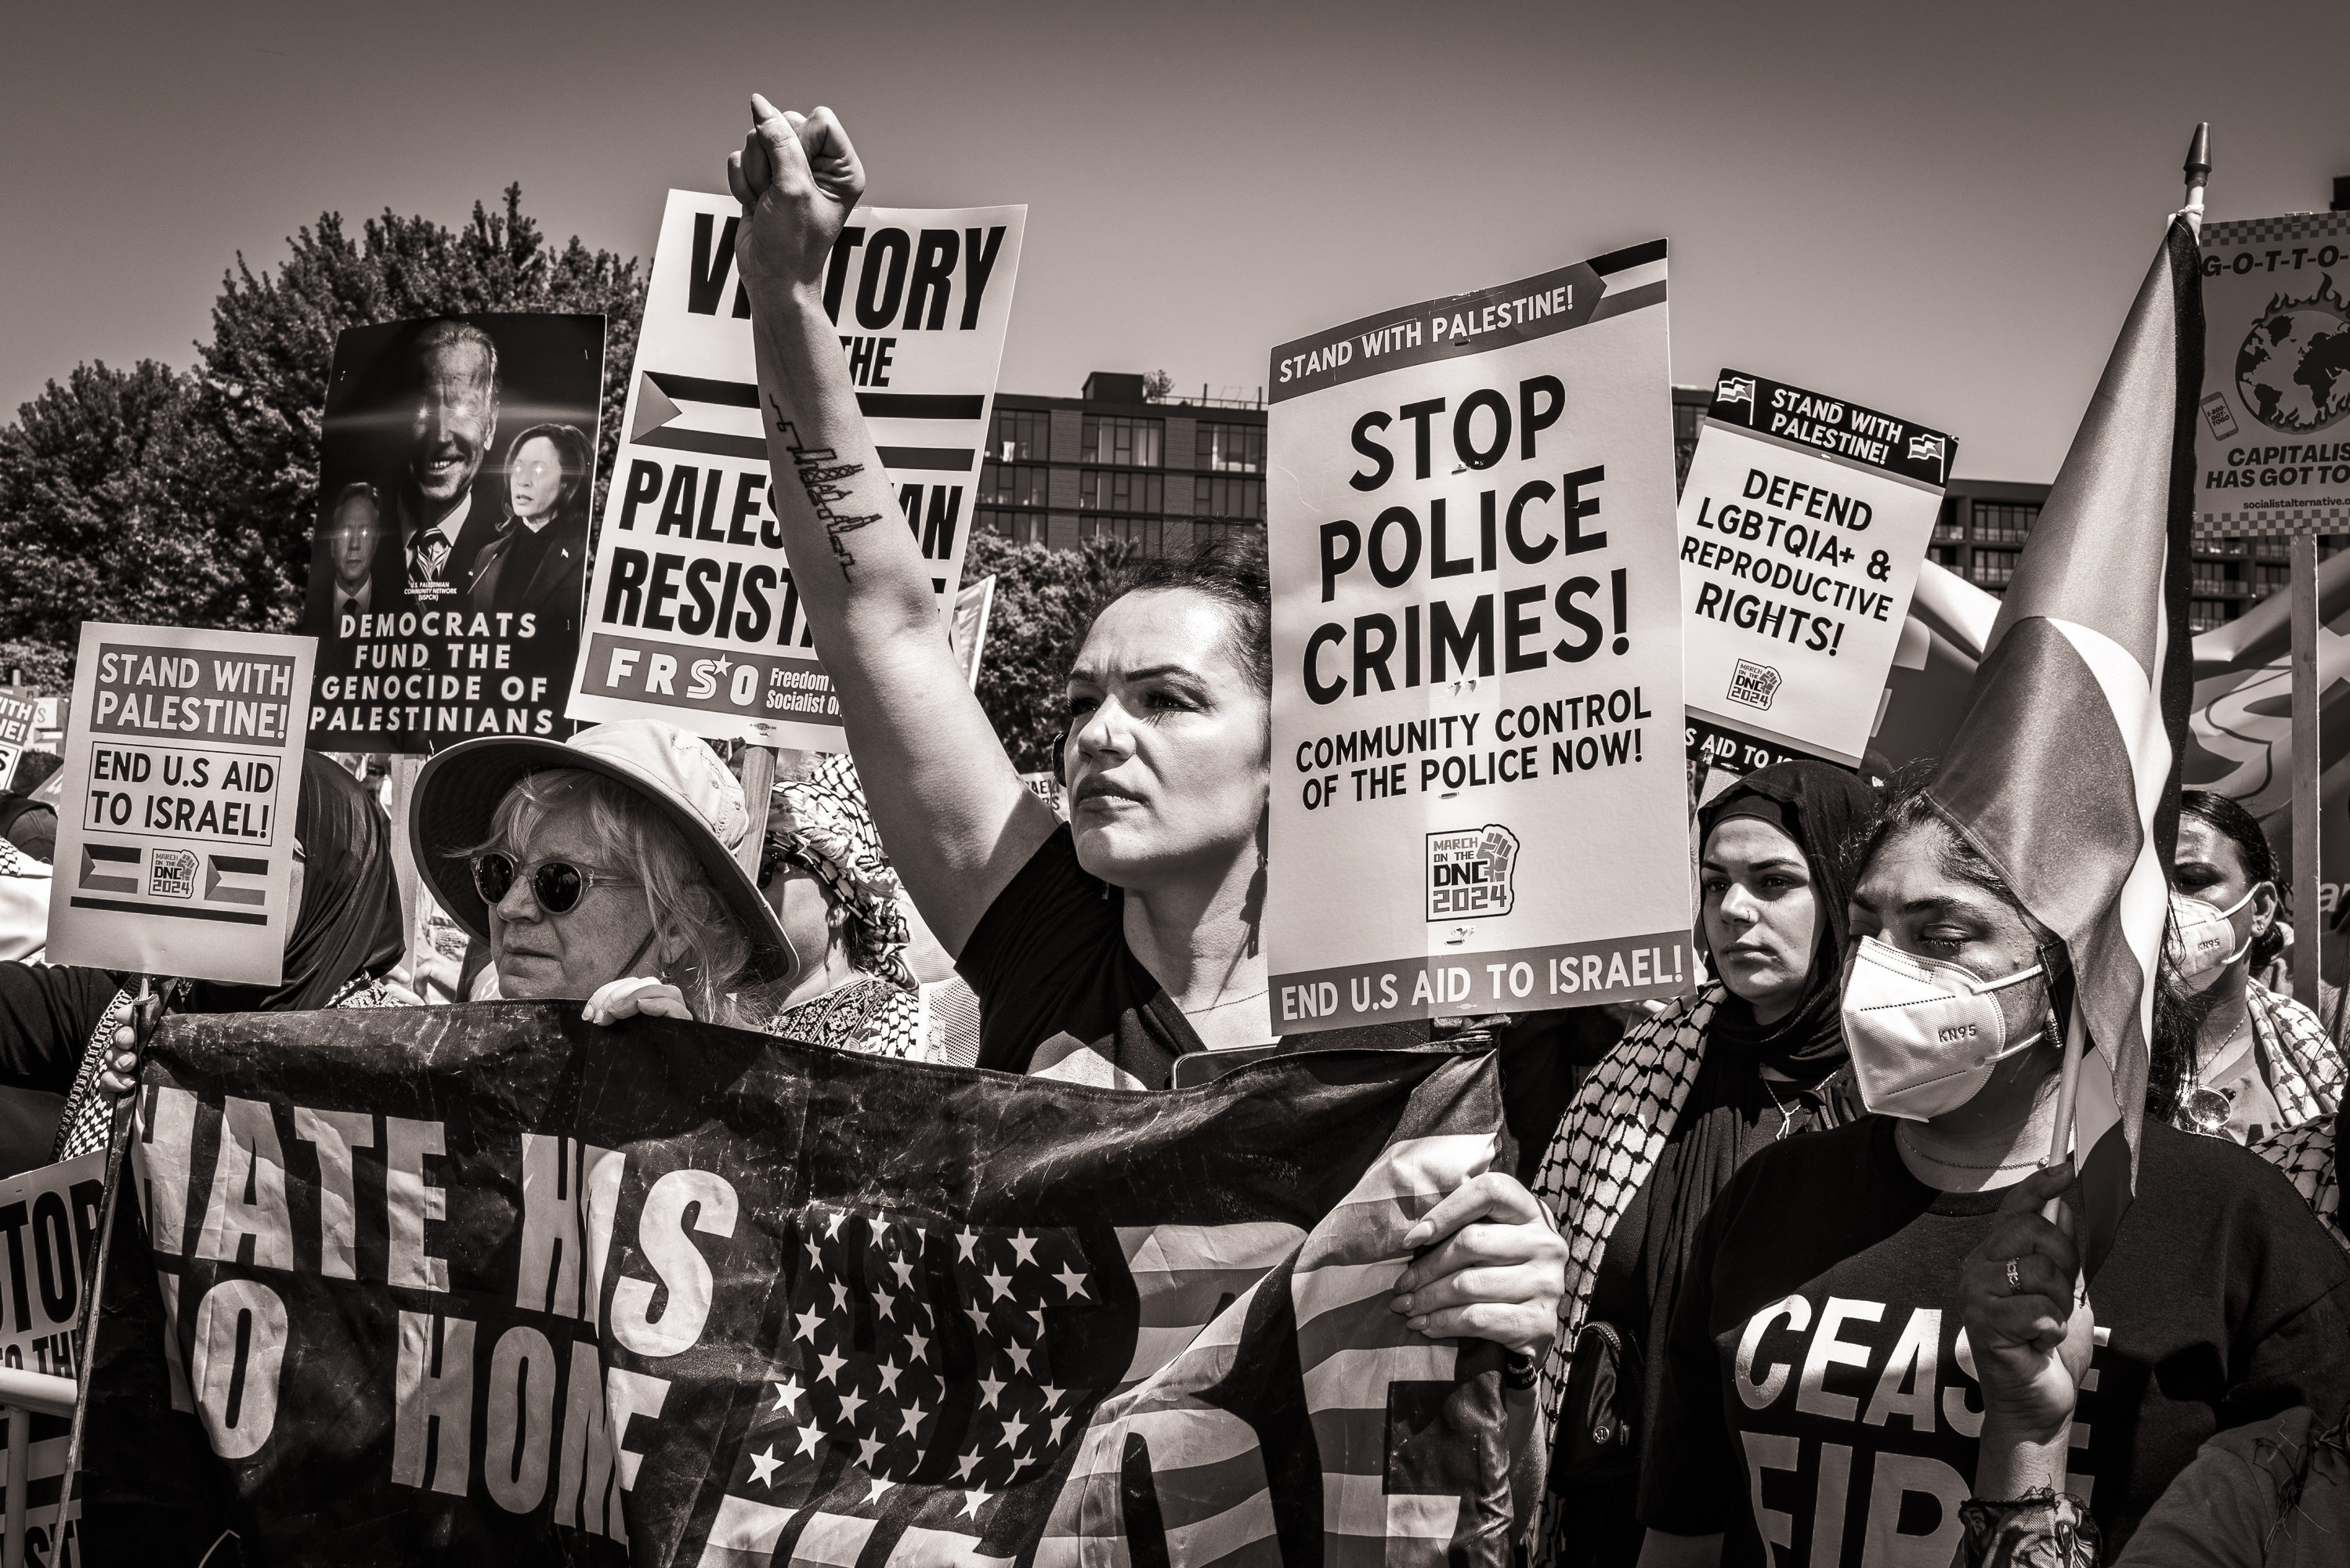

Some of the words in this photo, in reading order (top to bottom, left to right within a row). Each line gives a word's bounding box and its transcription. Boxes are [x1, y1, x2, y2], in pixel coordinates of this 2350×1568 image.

[688, 212, 1007, 331] VTORY
[1279, 341, 1353, 383] STAND
[1361, 321, 1422, 359] WITH
[1432, 284, 1573, 343] PALESTINE!
[1348, 374, 1565, 492] STOP
[1771, 388, 1843, 425] STAND
[1852, 410, 1903, 444] WITH
[1771, 413, 1889, 464] PALESTINE!
[2206, 469, 2255, 489] HAS
[2259, 466, 2314, 487] GOT
[2317, 464, 2350, 484] TO
[1742, 468, 1873, 532] DEFEND
[1320, 464, 1607, 603] POLICE
[1697, 497, 1855, 567] LGBTQIA+
[1866, 549, 1892, 583] &
[1680, 536, 1893, 623] REPRODUCTIVE
[340, 612, 536, 638] DEMOCRATS
[1694, 582, 1846, 656] RIGHTS!
[1303, 568, 1630, 706] CRIMES!
[355, 644, 428, 669] FUND
[447, 644, 511, 669] THE
[1740, 663, 1762, 674] MARCH
[99, 652, 200, 689] STAND
[214, 659, 291, 696] WITH
[321, 675, 481, 699] GENOCIDE
[501, 676, 548, 702] OF
[769, 667, 830, 692] Freedom
[1735, 674, 1764, 692] DNC
[766, 689, 826, 714] Socialist
[1731, 686, 1769, 706] 2024
[95, 691, 287, 739] PALESTINE!
[309, 706, 553, 735] PALESTINIANS
[1296, 713, 1480, 772] COMMUNITY
[1495, 686, 1651, 742] CONTROL
[1700, 734, 1737, 758] AID
[1744, 745, 1770, 768] TO
[94, 750, 150, 784] END
[163, 754, 210, 789] U.S
[221, 761, 274, 793] AID
[1302, 778, 1338, 811] OF
[1354, 763, 1407, 802] THE
[1421, 746, 1538, 793] POLICE
[1553, 728, 1643, 775] NOW!
[90, 790, 132, 826] TO
[145, 795, 269, 839] ISRAEL!
[1434, 837, 1477, 851] MARCH
[1434, 853, 1448, 862] ON
[1454, 851, 1474, 861] THE
[153, 880, 190, 894] 2024
[154, 866, 182, 880] DNC
[1434, 861, 1488, 887] DNC
[1433, 884, 1506, 913] 2024
[2196, 938, 2220, 952] KN95
[1281, 982, 1337, 1021] END
[1350, 974, 1398, 1013] U.S
[1411, 966, 1471, 1006] AID
[1487, 960, 1534, 999] TO
[1549, 945, 1683, 995] ISRAEL!
[1938, 1024, 1976, 1042] KN95
